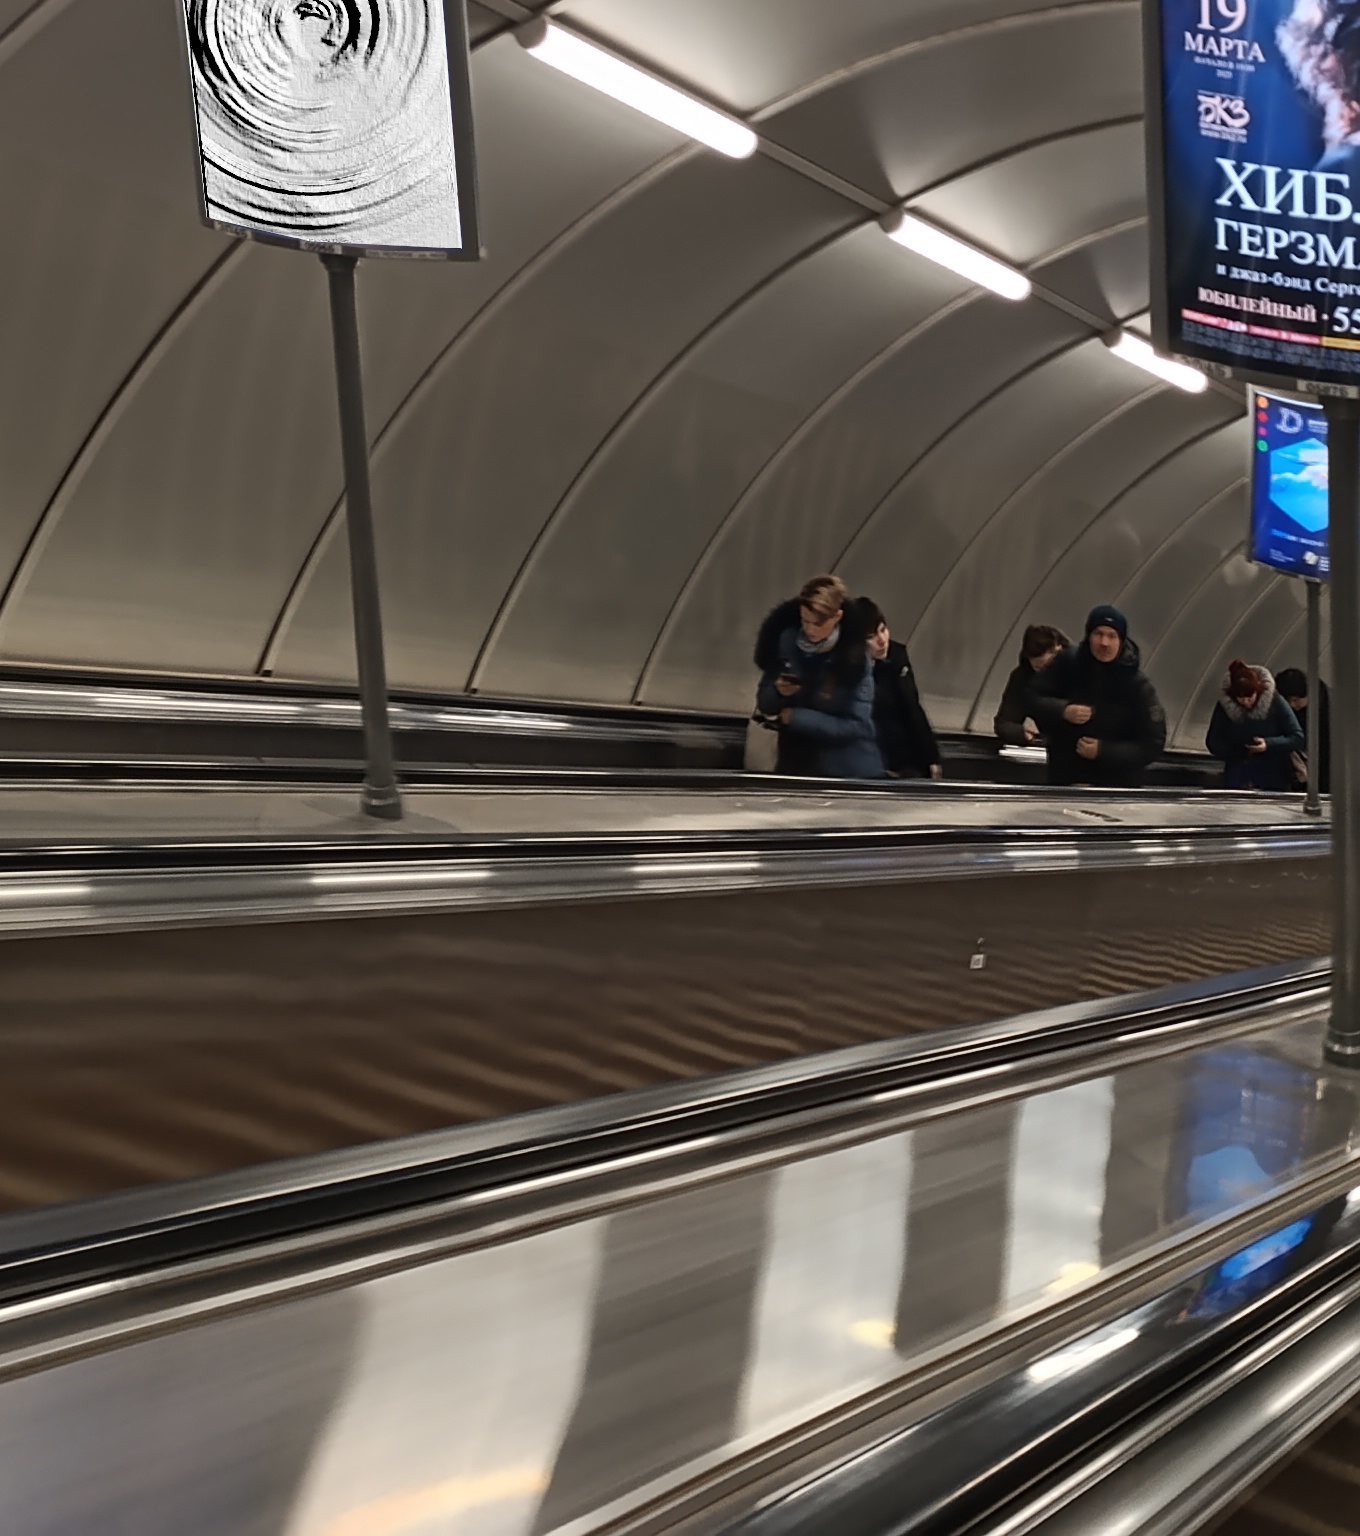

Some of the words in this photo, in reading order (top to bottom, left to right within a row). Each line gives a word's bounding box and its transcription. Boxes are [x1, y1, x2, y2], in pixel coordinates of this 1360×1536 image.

[1184, 31, 1266, 63] МАРТА
[1229, 266, 1311, 292] джаз-бэнд
[1198, 286, 1317, 323] ЮБИЛЕЙНЫЙ
